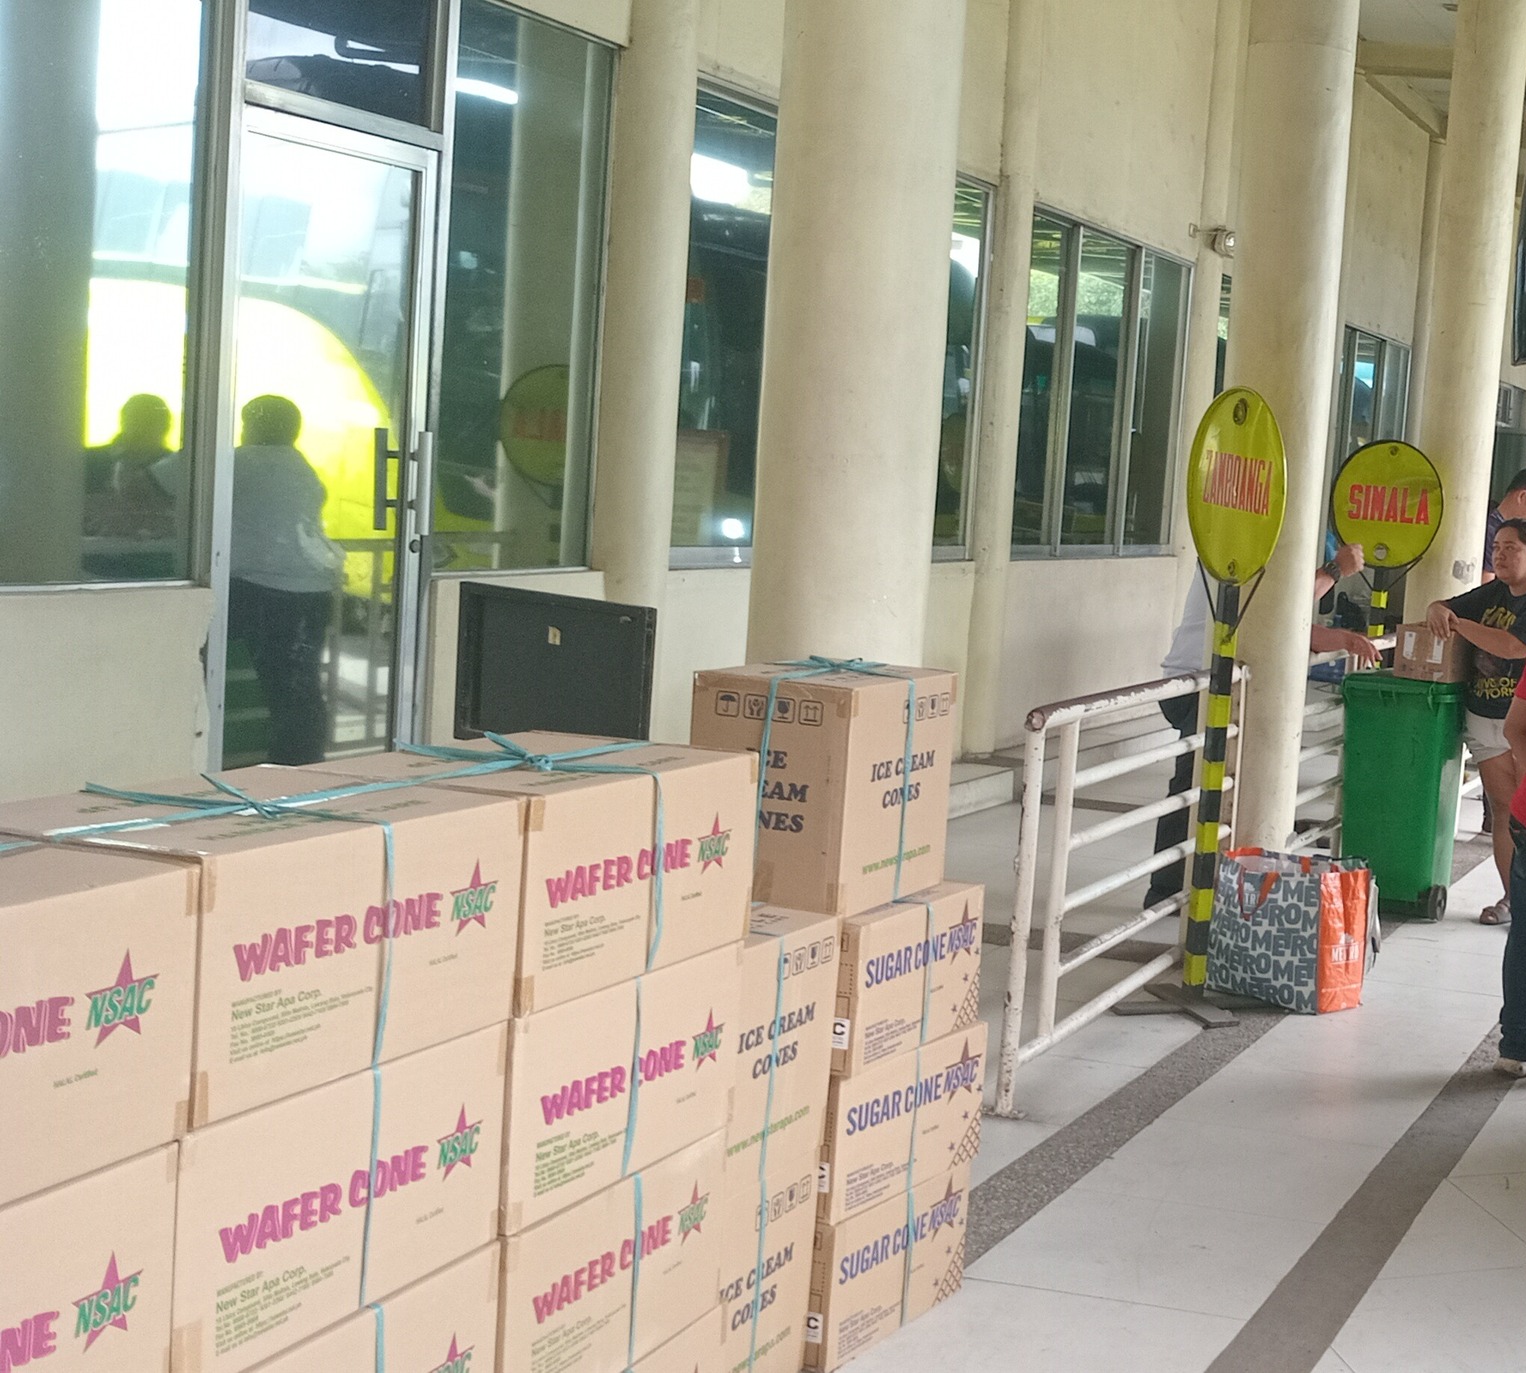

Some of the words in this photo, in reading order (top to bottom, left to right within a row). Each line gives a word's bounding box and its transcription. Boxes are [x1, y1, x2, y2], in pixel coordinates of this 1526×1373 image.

[1203, 449, 1273, 517] ZAMBOANGA
[1348, 484, 1430, 526] SIMALA
[870, 760, 893, 783] ICE
[545, 850, 633, 909] WAFER
[697, 833, 731, 862] NSAC
[233, 914, 357, 982] WAFER
[363, 892, 443, 945] CONE
[451, 885, 496, 921] NSAC
[865, 946, 913, 988] SUGAR
[947, 922, 977, 955] NSAC
[1251, 927, 1319, 957] METRO
[86, 978, 156, 1031] NSAC
[737, 1025, 764, 1054] ICE
[541, 1066, 627, 1125] WAFER
[692, 1025, 723, 1061] NSAC
[846, 1090, 902, 1136] SUGAR
[904, 1072, 943, 1113] CONE
[943, 1059, 979, 1093] NSAC
[219, 1182, 342, 1263] WAFER
[349, 1145, 429, 1207] CONE
[438, 1124, 480, 1169] NSAC
[532, 1252, 615, 1324] WAFER
[678, 1197, 708, 1236] NSAC
[838, 1233, 890, 1285] SUGAR
[928, 1195, 962, 1232] NSAC
[75, 1275, 140, 1338] NSAC
